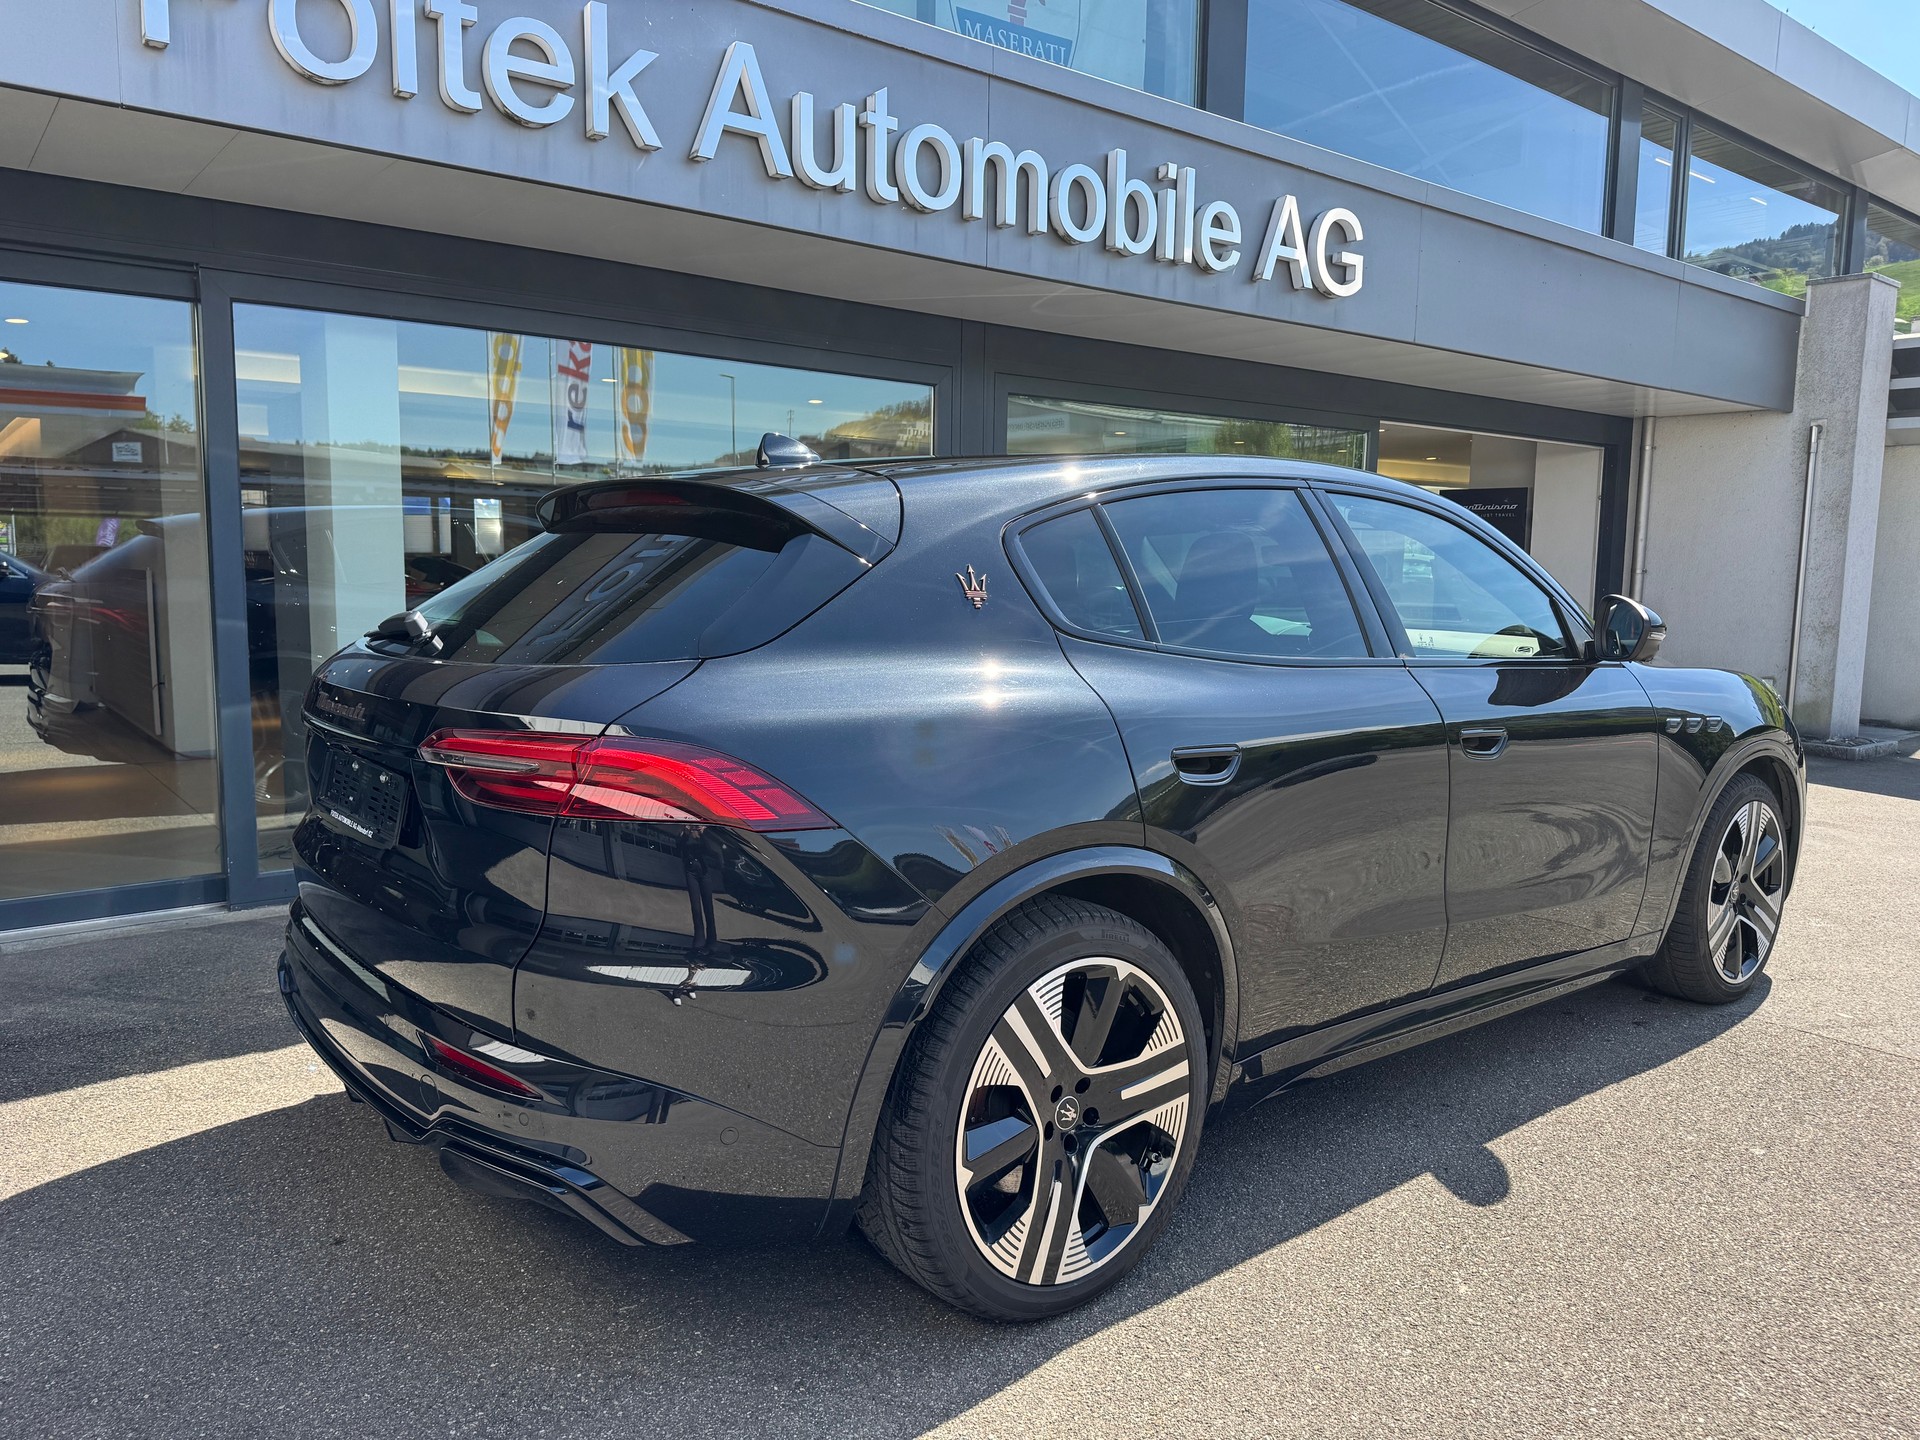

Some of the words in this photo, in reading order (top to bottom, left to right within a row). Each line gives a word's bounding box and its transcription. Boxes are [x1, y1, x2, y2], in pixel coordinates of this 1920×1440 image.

[964, 19, 1067, 66] MASERATI
[688, 41, 1241, 274] Automobile
[1253, 194, 1364, 299] AG
